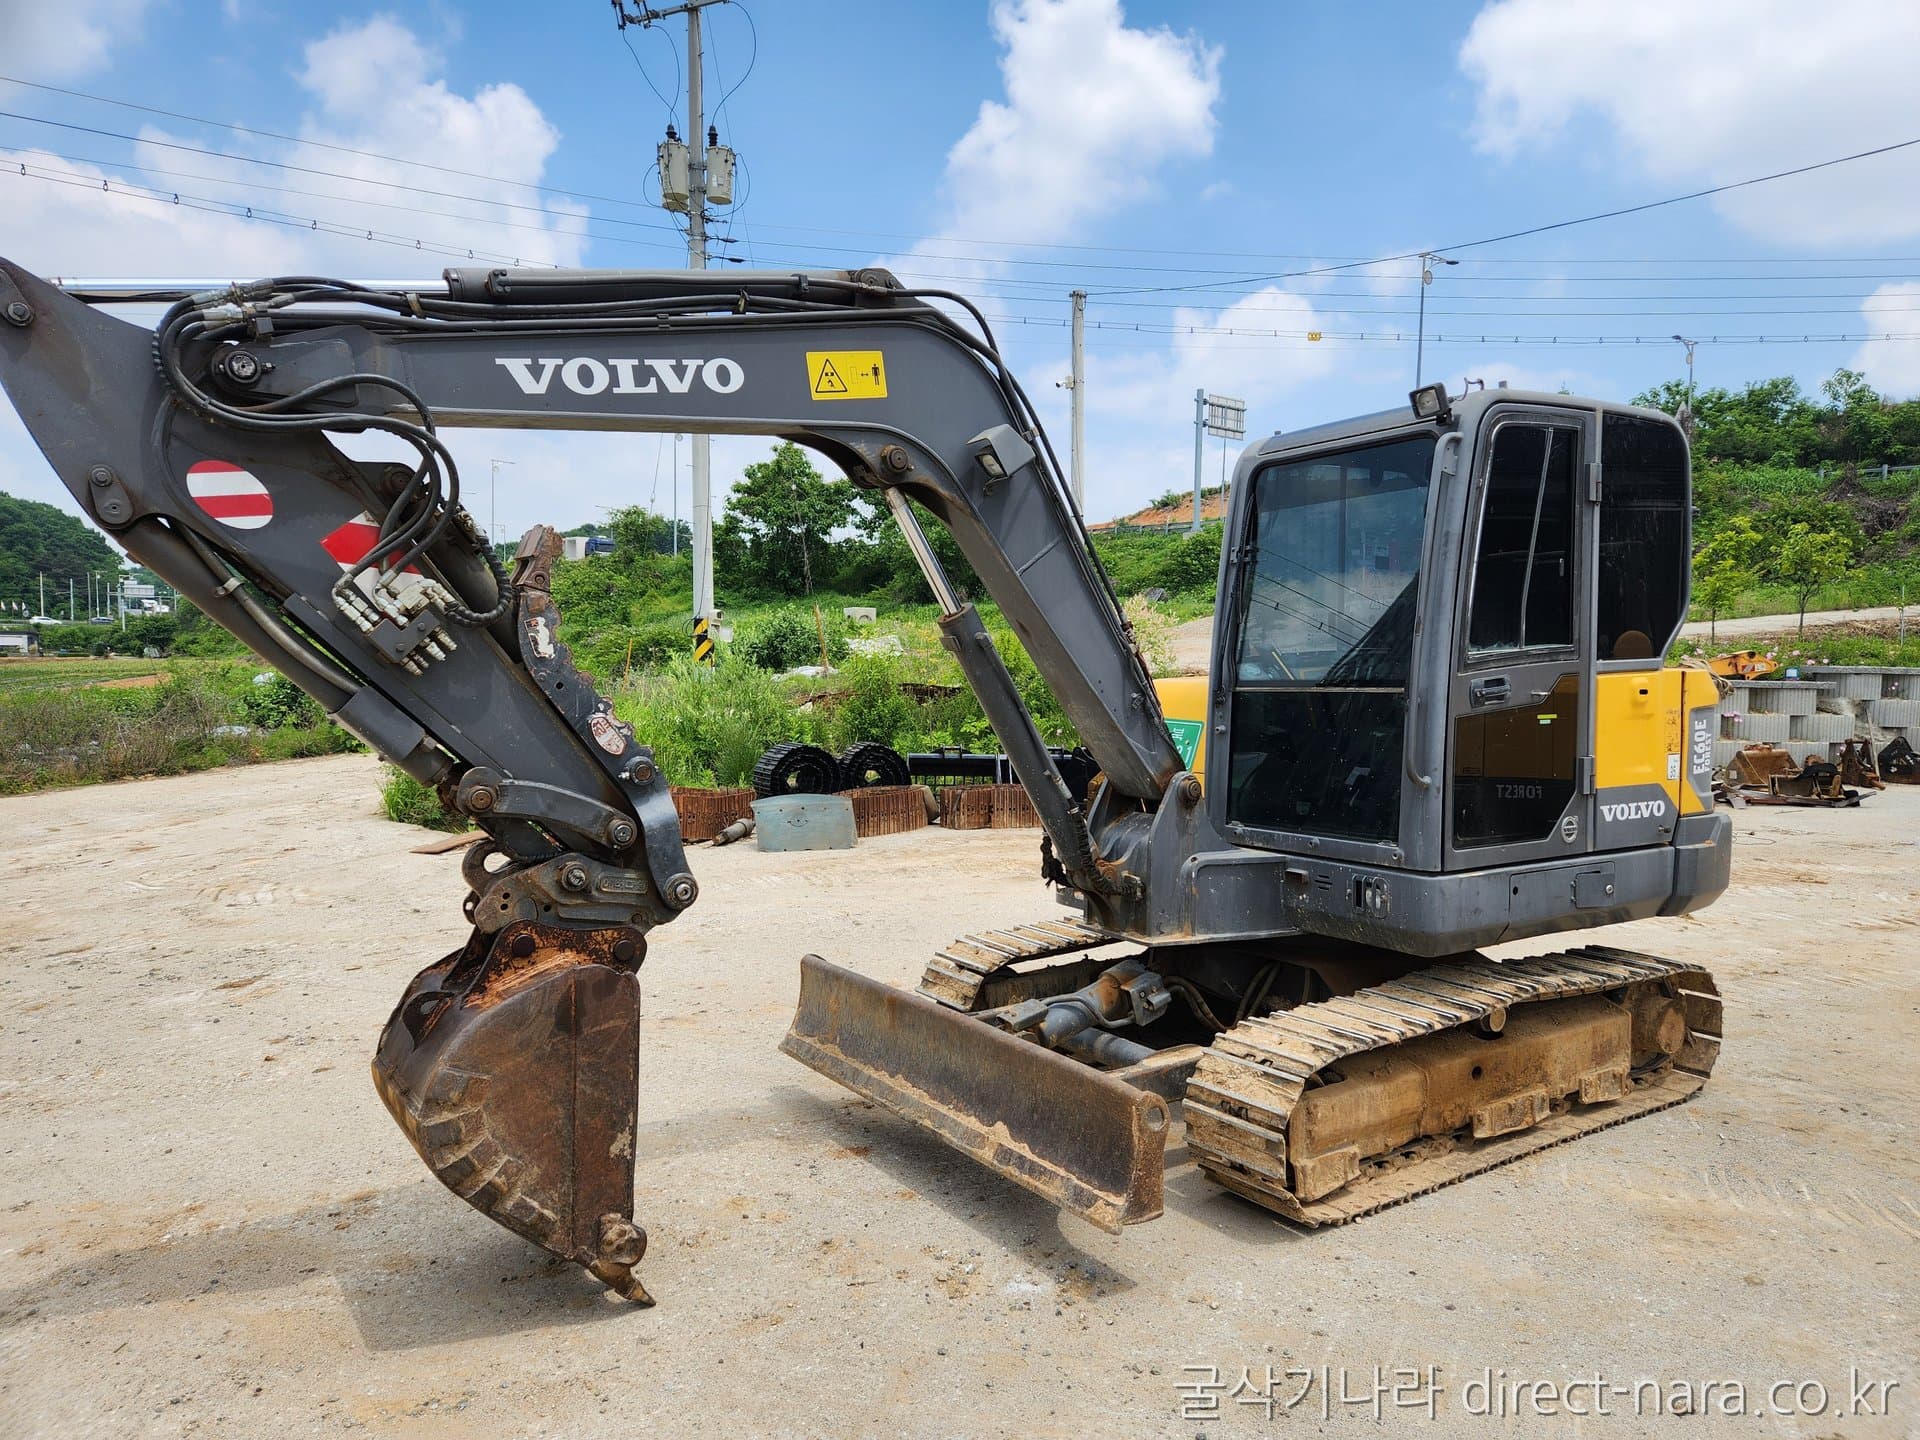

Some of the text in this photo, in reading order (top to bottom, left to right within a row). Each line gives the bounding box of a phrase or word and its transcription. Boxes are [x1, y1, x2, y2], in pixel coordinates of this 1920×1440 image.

[495, 357, 745, 395] VOLVO
[1693, 719, 1707, 775] EC60E
[1704, 733, 1713, 772] FOREST
[1600, 800, 1665, 822] VOLVO
